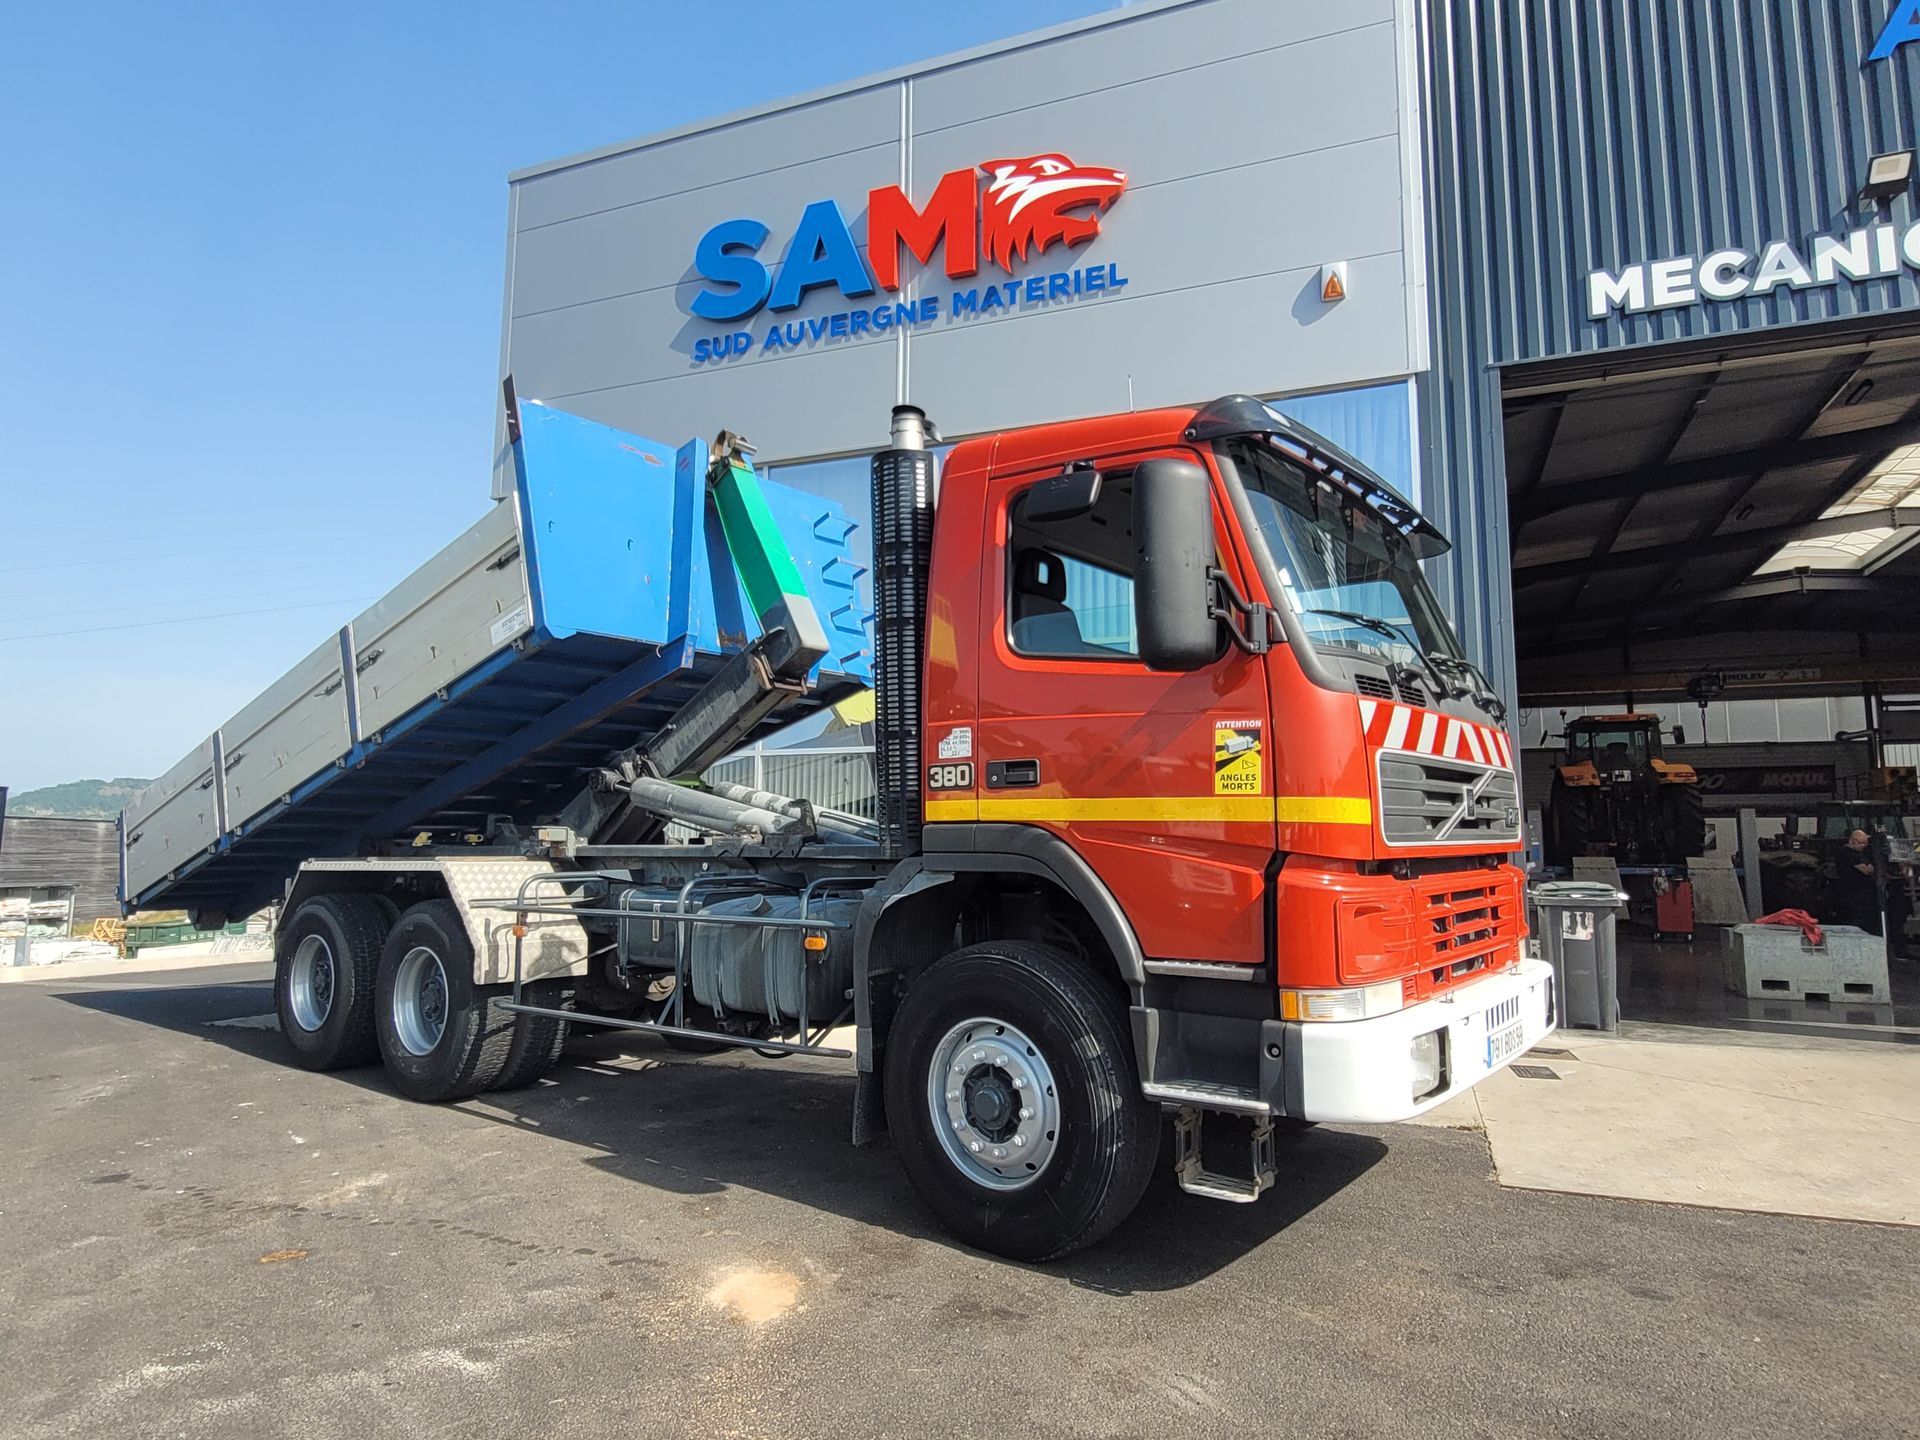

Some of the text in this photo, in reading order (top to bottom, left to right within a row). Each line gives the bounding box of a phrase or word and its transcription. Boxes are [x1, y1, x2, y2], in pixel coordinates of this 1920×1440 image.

[690, 167, 978, 323] SAM
[693, 263, 1129, 363] SUD AUVERGNE MATERIEL
[1215, 720, 1262, 729] ATTENTION
[929, 765, 970, 788] 380
[1220, 773, 1257, 781] ANGLES
[1761, 771, 1828, 786] MOTUL
[1222, 782, 1255, 791] MORTS
